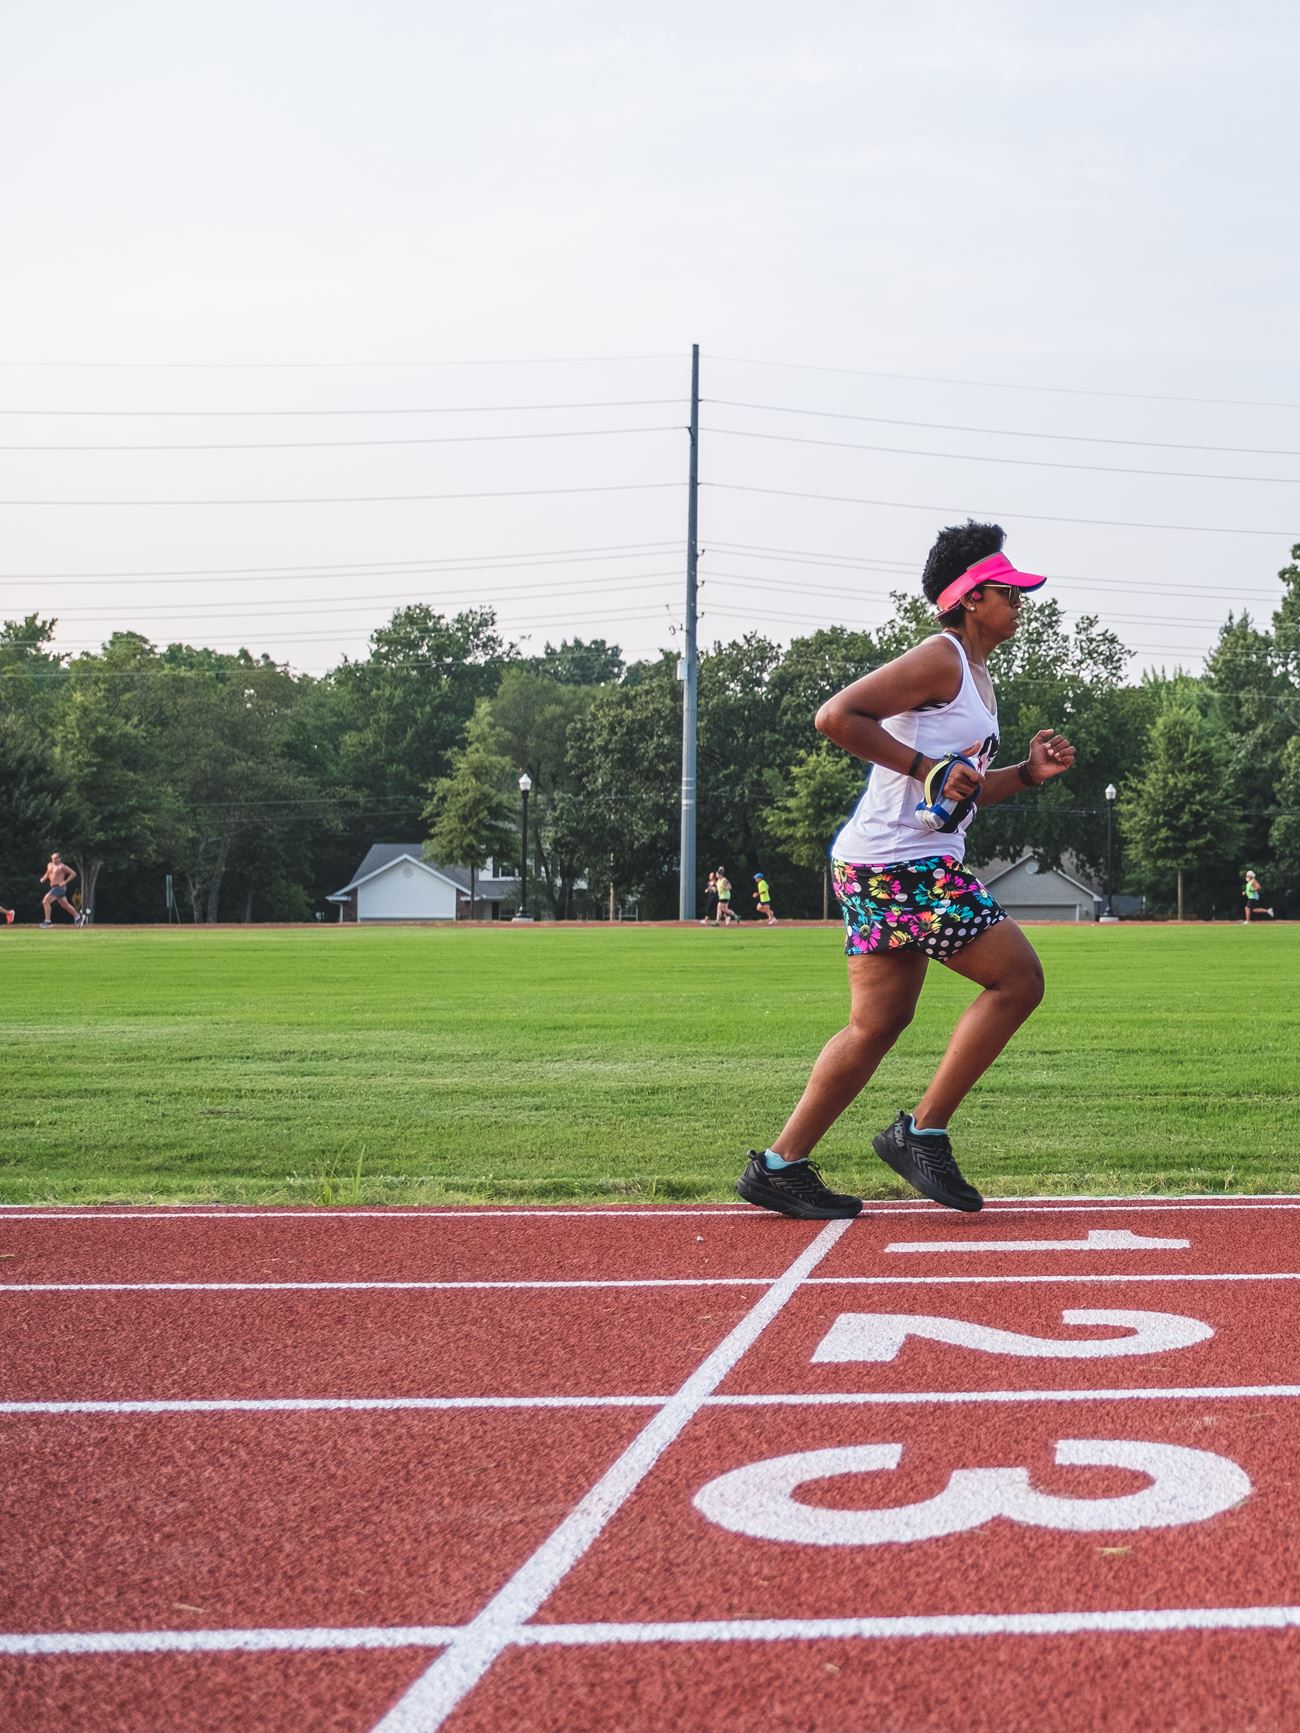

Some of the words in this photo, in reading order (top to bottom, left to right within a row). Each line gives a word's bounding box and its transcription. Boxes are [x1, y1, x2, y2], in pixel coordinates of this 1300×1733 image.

[884, 1229, 1191, 1253] 1
[809, 1308, 1216, 1364] 2
[692, 1438, 1254, 1547] 3
